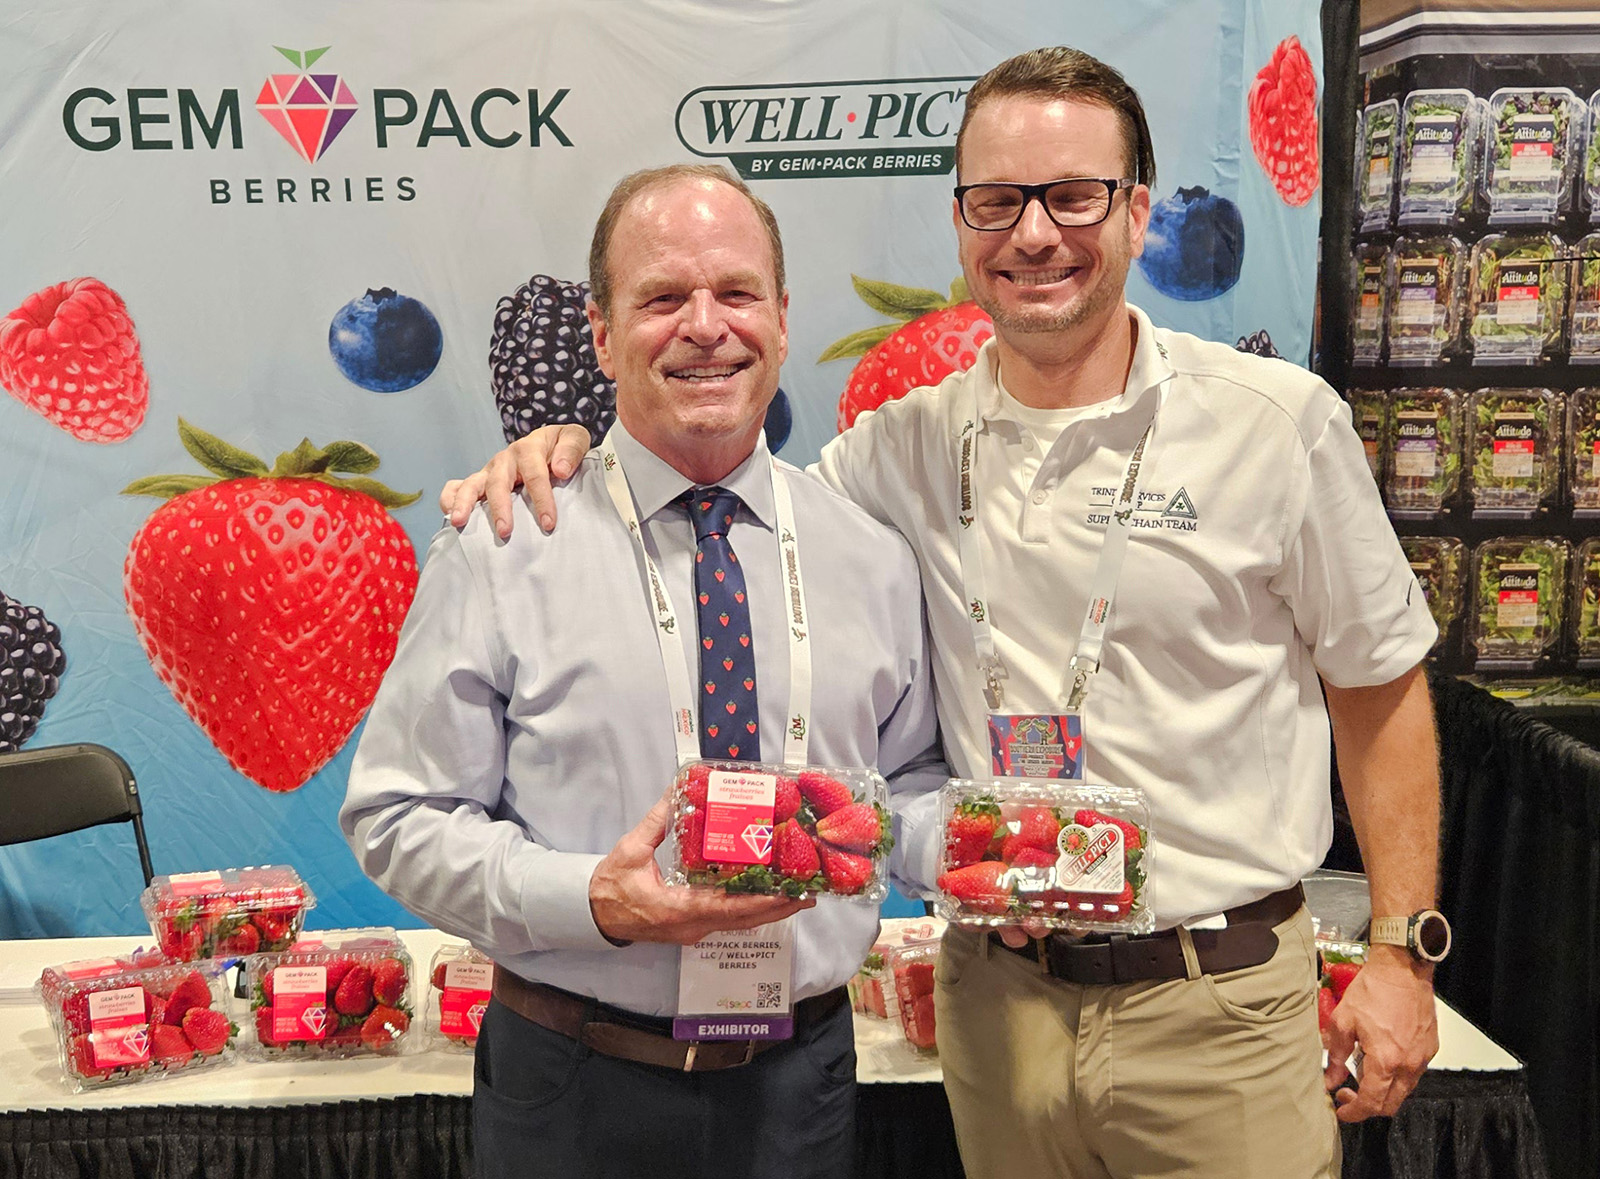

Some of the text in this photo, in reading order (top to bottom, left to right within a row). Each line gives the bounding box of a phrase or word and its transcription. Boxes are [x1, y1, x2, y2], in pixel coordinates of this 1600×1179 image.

[63, 87, 574, 152] GEM PACK
[1415, 127, 1453, 141] Attitude
[1514, 127, 1552, 141] Attitude
[751, 159, 773, 172] BY
[872, 154, 942, 169] BERRIES
[210, 176, 418, 204] BERRIES
[1501, 270, 1538, 284] Attitude
[1398, 423, 1436, 436] Attitude
[1495, 424, 1532, 437] Attitude
[1131, 518, 1164, 529] HAIN
[1165, 519, 1198, 532] TEAM
[1500, 575, 1537, 588] Attitude
[694, 941, 782, 950] GEM-PACK BERRIES,
[700, 951, 717, 959] LLC
[719, 961, 757, 969] BERRIES
[698, 1024, 770, 1036] EXHIBITOR
